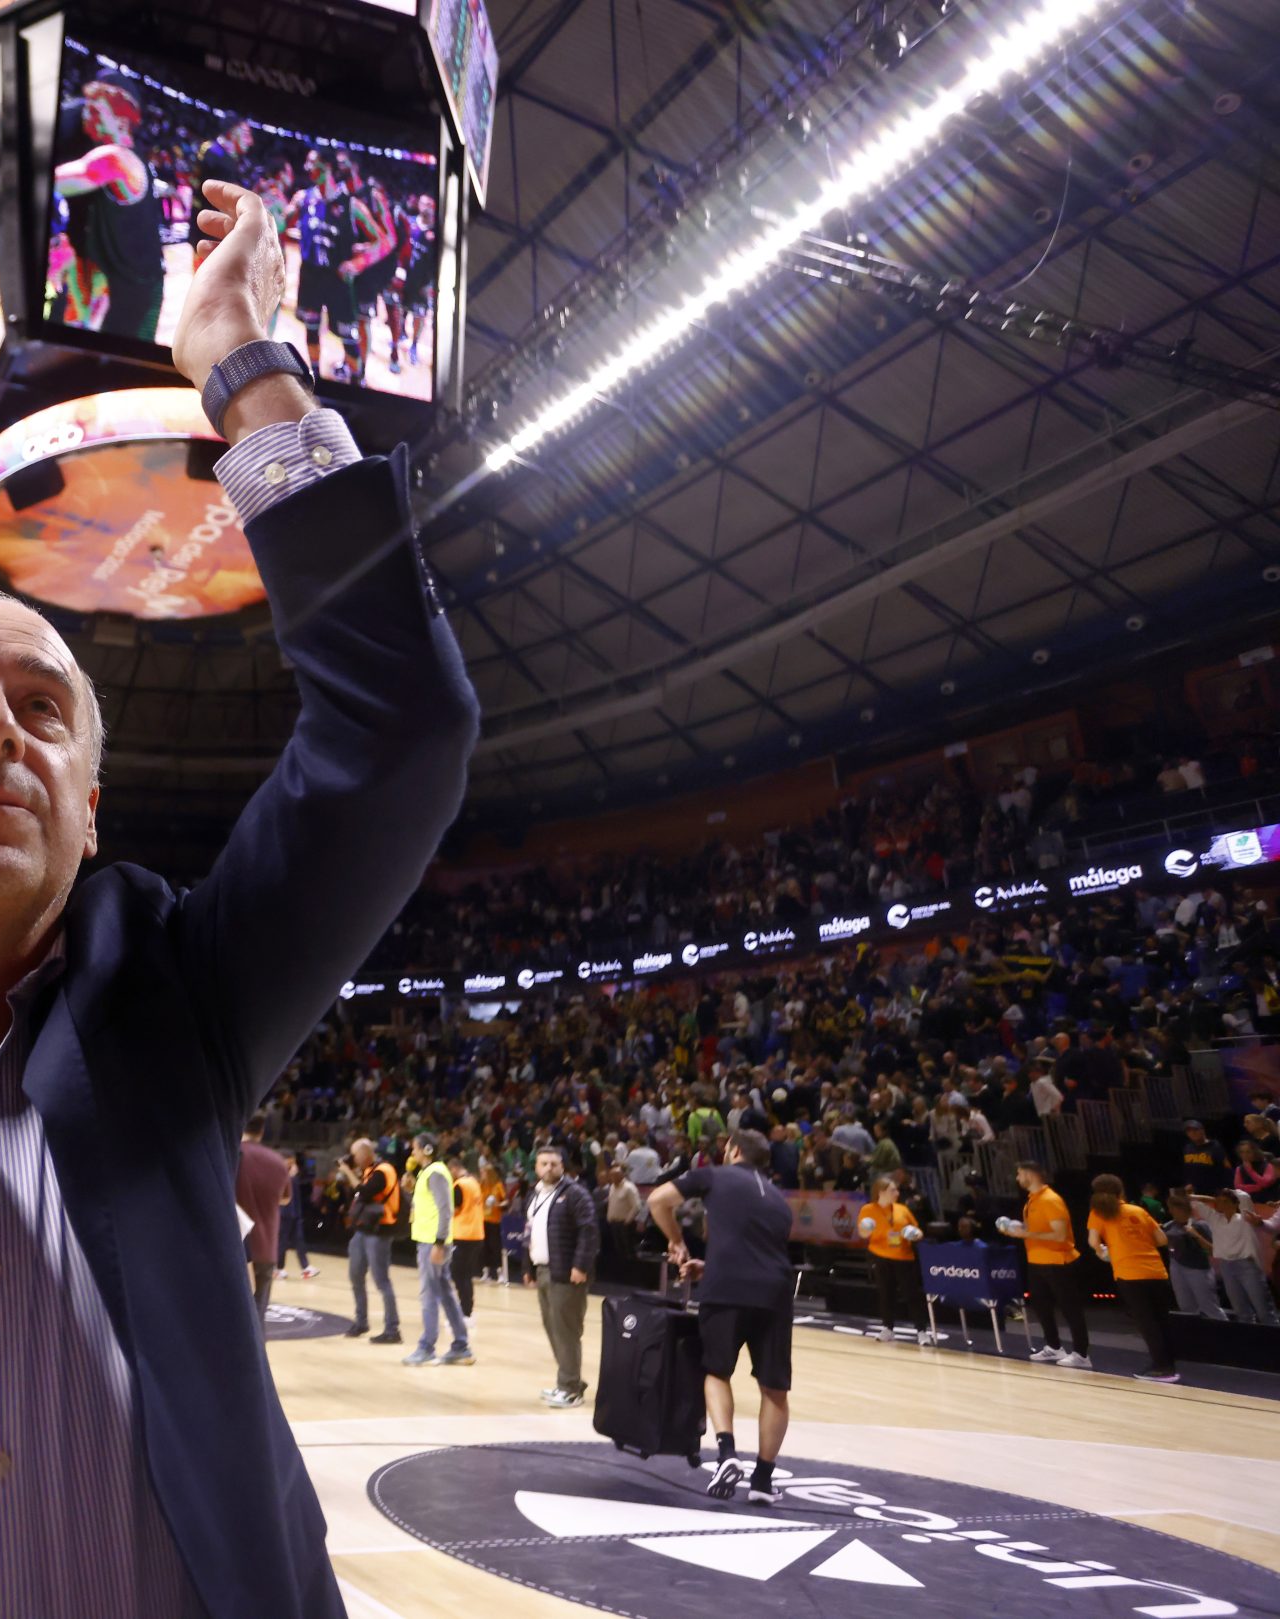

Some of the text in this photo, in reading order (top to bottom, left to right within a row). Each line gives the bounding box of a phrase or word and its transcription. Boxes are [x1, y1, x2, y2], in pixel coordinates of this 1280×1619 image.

[1069, 864, 1143, 891] málaga
[819, 915, 871, 938] málaga
[929, 1265, 980, 1279] endesa
